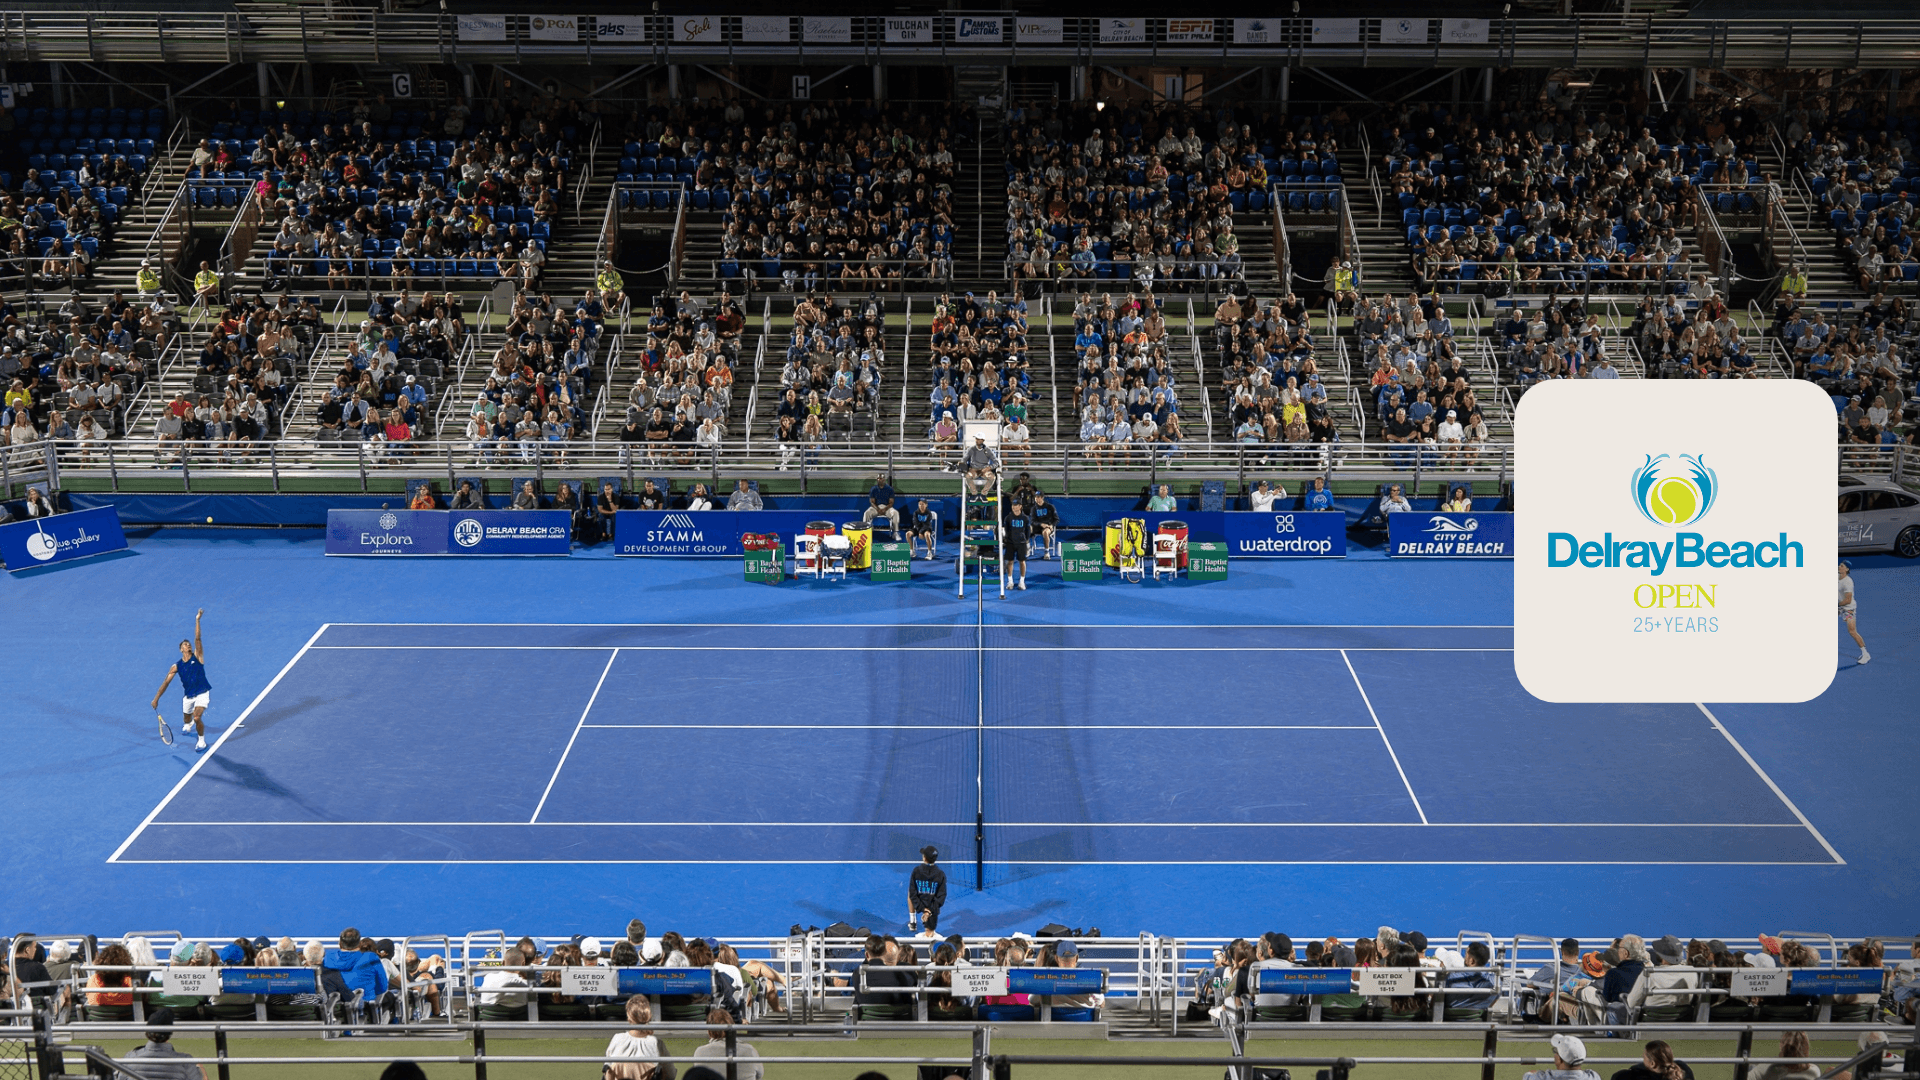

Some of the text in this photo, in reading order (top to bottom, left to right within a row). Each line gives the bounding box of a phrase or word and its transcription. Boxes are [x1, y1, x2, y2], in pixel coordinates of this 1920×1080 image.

[547, 19, 575, 29] PGA
[598, 23, 625, 36] abs
[684, 17, 712, 41] Stoli
[887, 20, 930, 30] TULCHAN
[1018, 24, 1039, 34] VIP
[1169, 20, 1213, 33] ESPN
[901, 30, 917, 39] GIN
[395, 75, 409, 96] G
[795, 77, 808, 98] H
[36, 519, 101, 549] blue gallery
[647, 530, 704, 542] STAMM
[1434, 533, 1473, 541] CITY OF
[1858, 523, 1874, 542] i4
[360, 532, 413, 548] Explora
[1239, 536, 1332, 555] waterdrop
[624, 545, 727, 553] DEVELOPMENT GROUP
[1398, 542, 1504, 554] DELRAY BEACH
[887, 559, 909, 567] Baptist
[1204, 558, 1228, 566] Baptist
